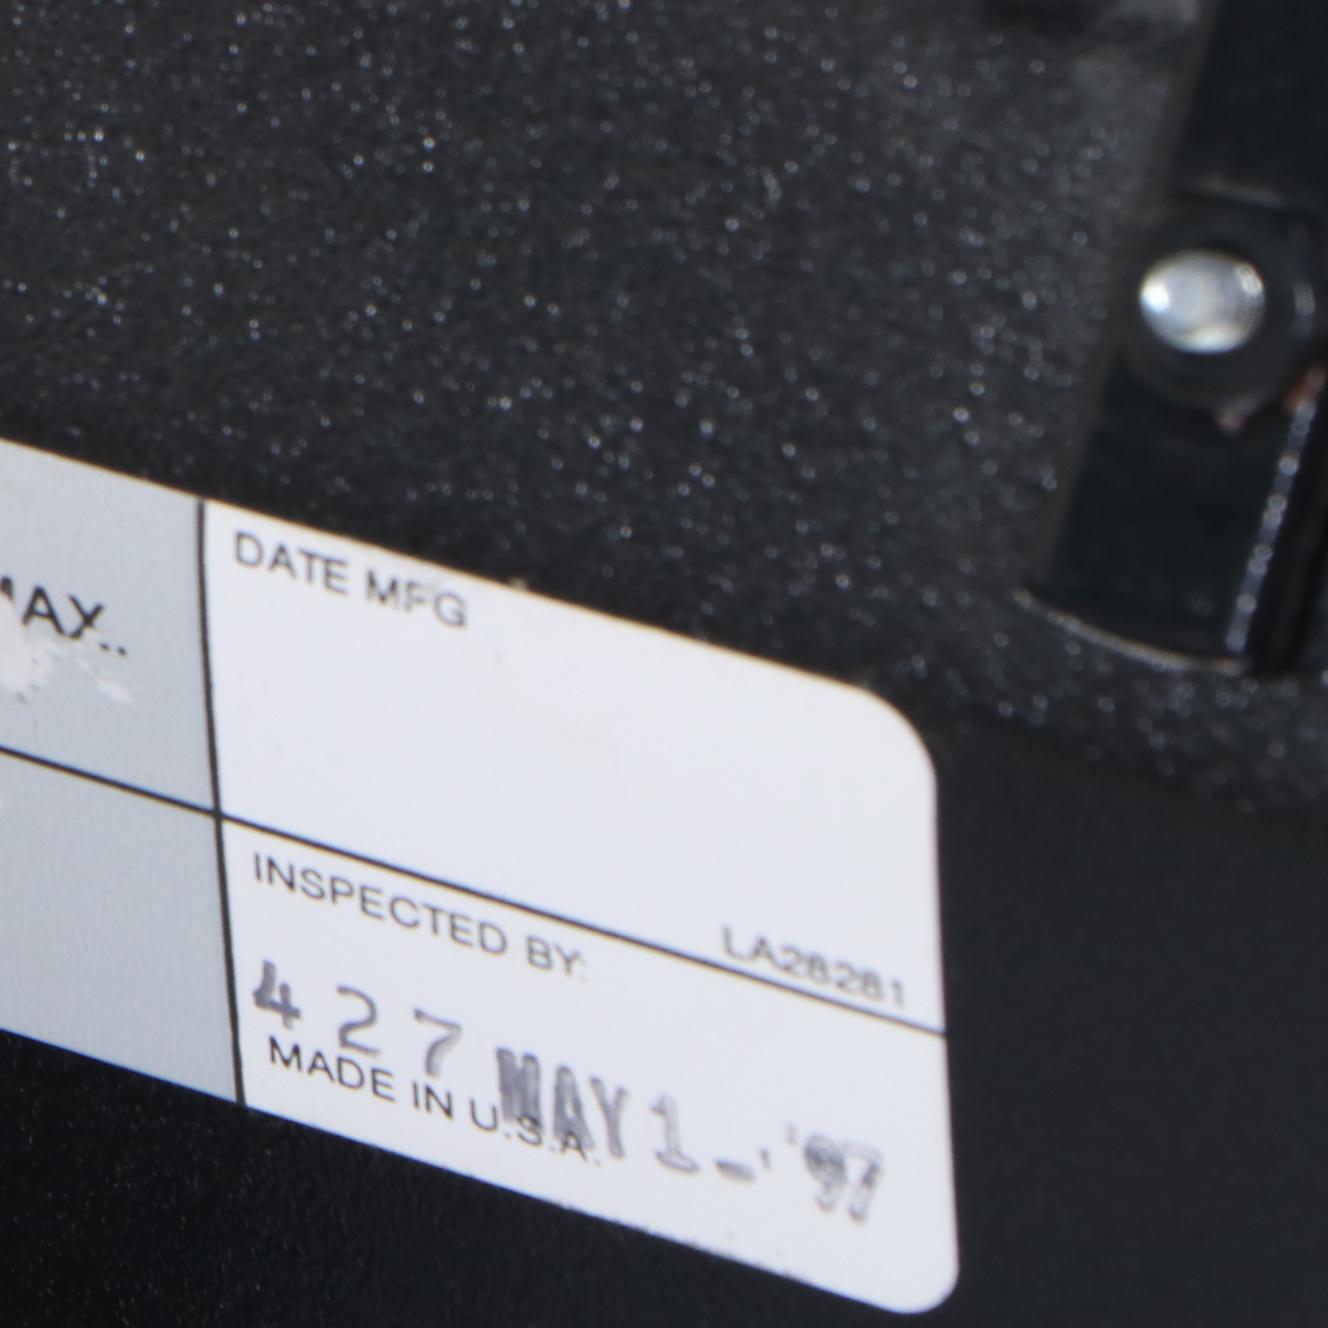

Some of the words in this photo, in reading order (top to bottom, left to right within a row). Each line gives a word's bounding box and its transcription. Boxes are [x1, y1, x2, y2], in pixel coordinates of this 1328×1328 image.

[235, 531, 348, 595] DATE
[364, 569, 467, 630] MFG
[252, 851, 509, 958] INSPECTED
[526, 934, 588, 983] BY:
[269, 1035, 397, 1103] MADE
[410, 1083, 454, 1118] IN
